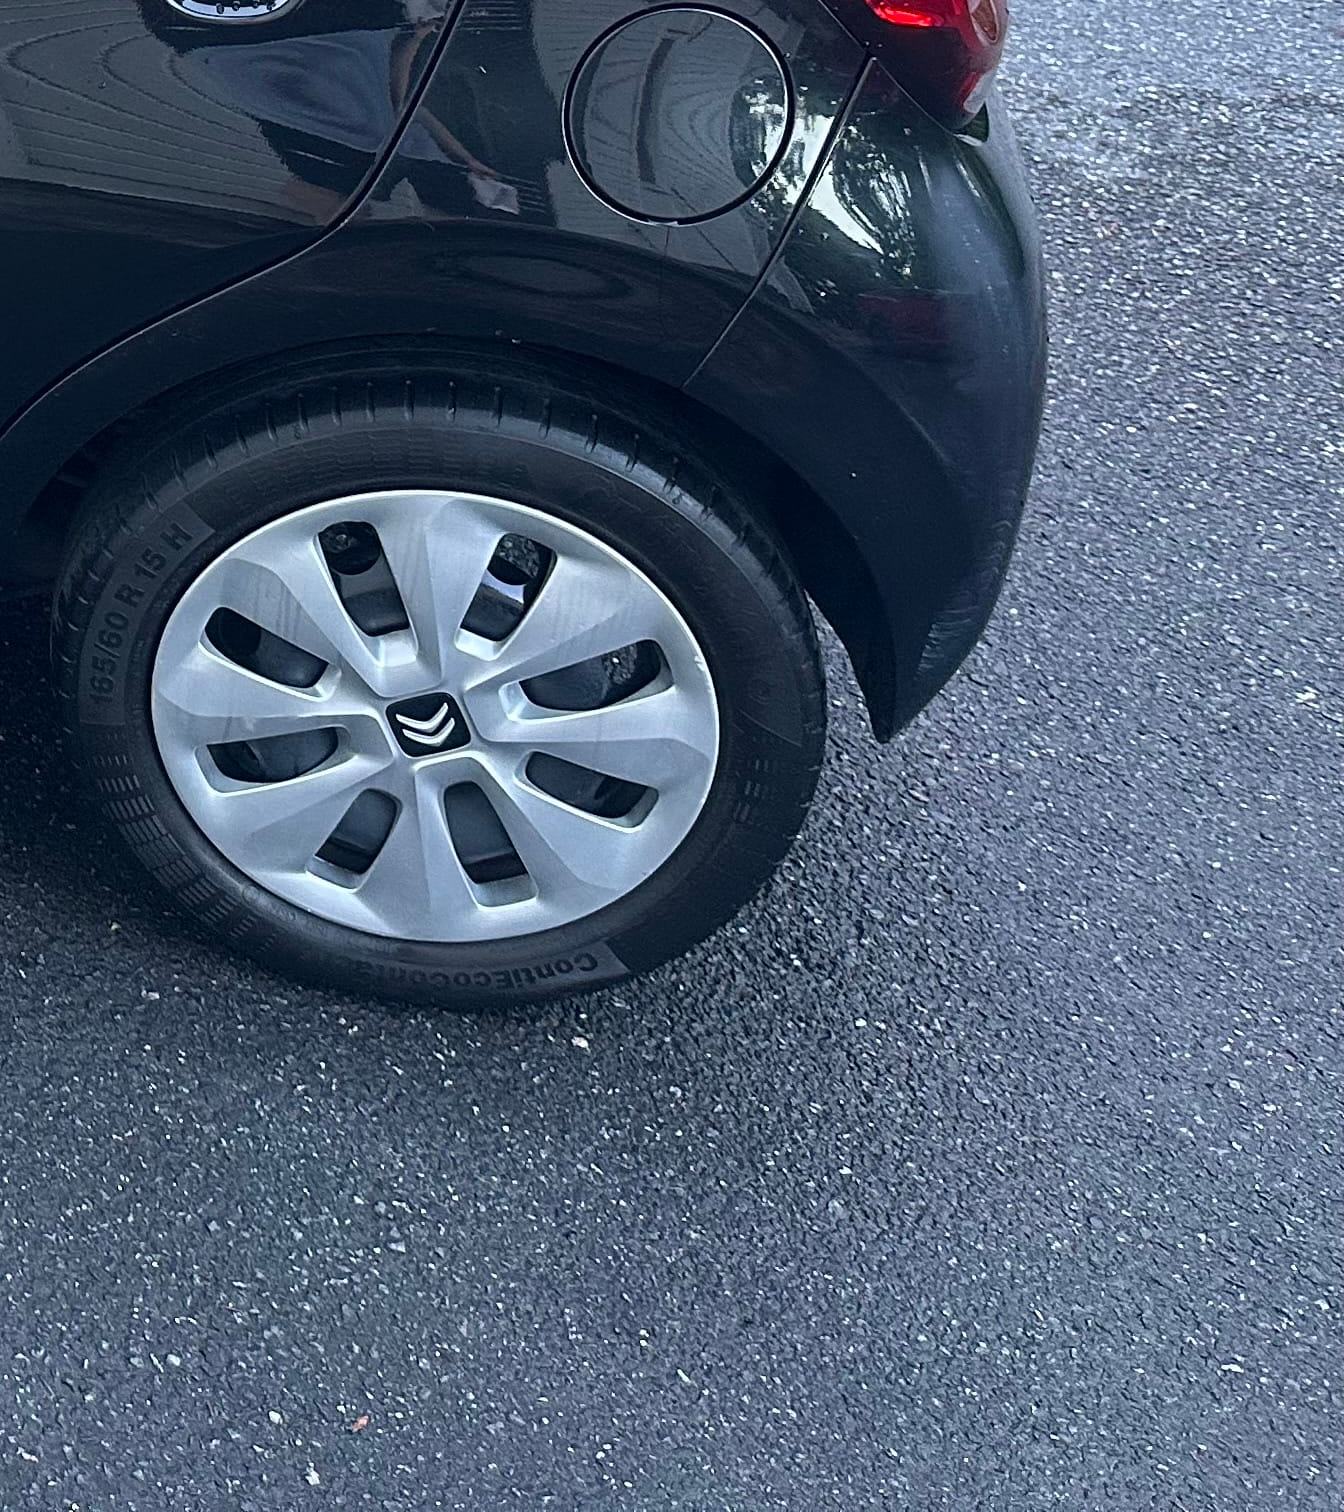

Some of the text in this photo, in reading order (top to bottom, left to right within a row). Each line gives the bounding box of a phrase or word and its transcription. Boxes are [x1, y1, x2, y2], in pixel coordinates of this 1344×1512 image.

[88, 521, 194, 705] 165/60 R 15 H
